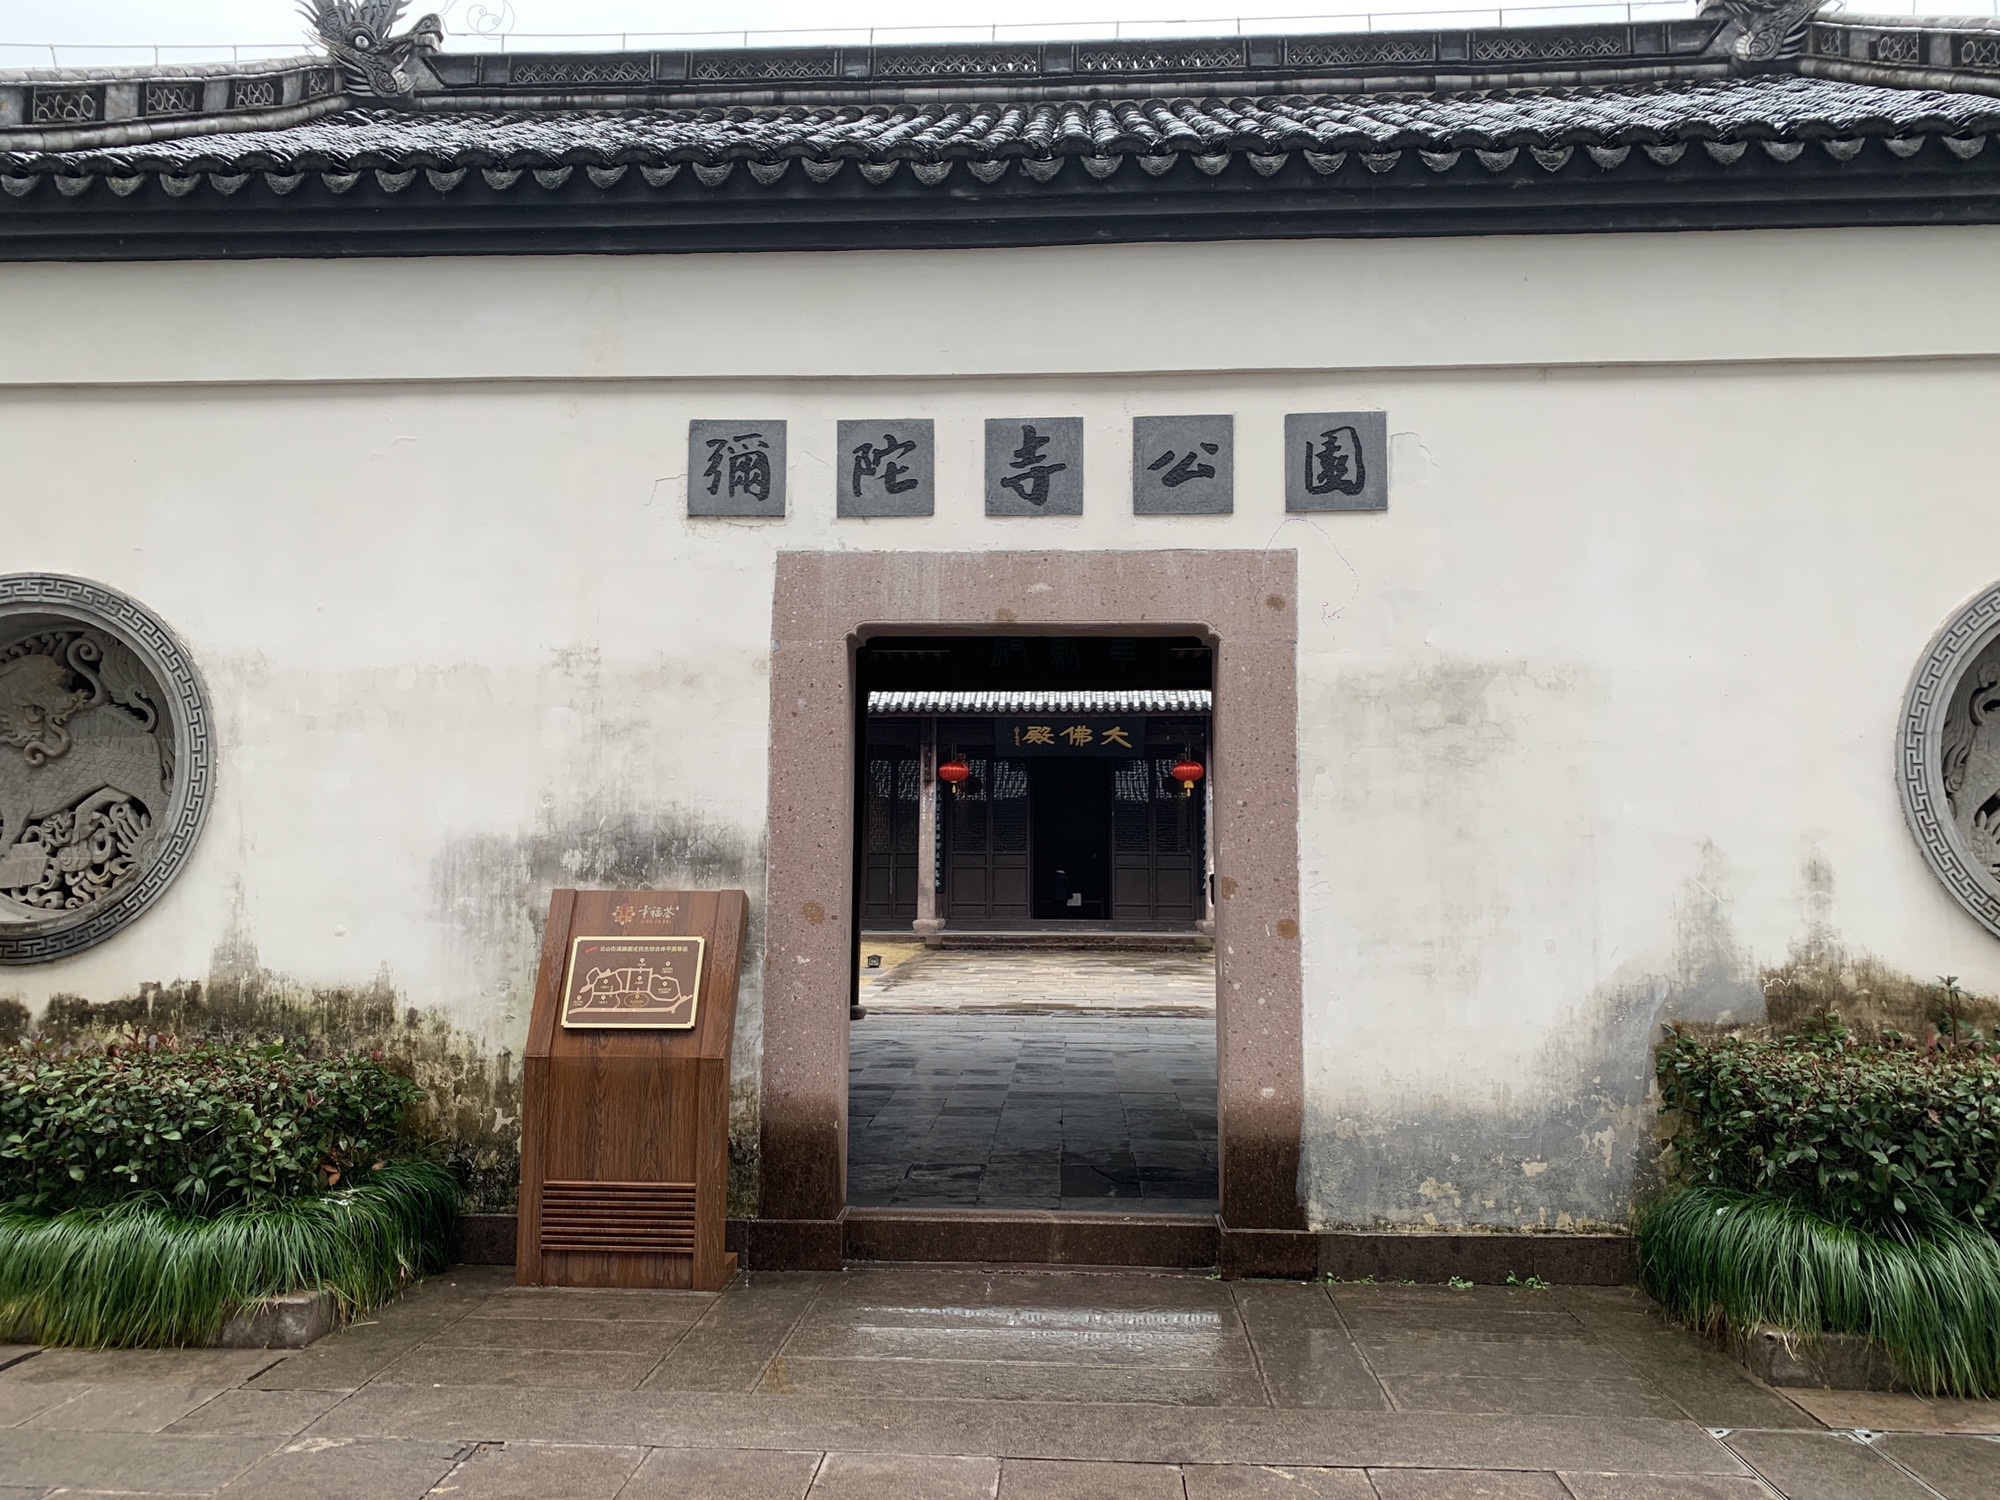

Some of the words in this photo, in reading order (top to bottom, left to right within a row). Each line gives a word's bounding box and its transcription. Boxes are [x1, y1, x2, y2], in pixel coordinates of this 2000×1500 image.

[704, 426, 1366, 506] 彌陀寺公園
[1022, 725, 1133, 748] 大佛殿
